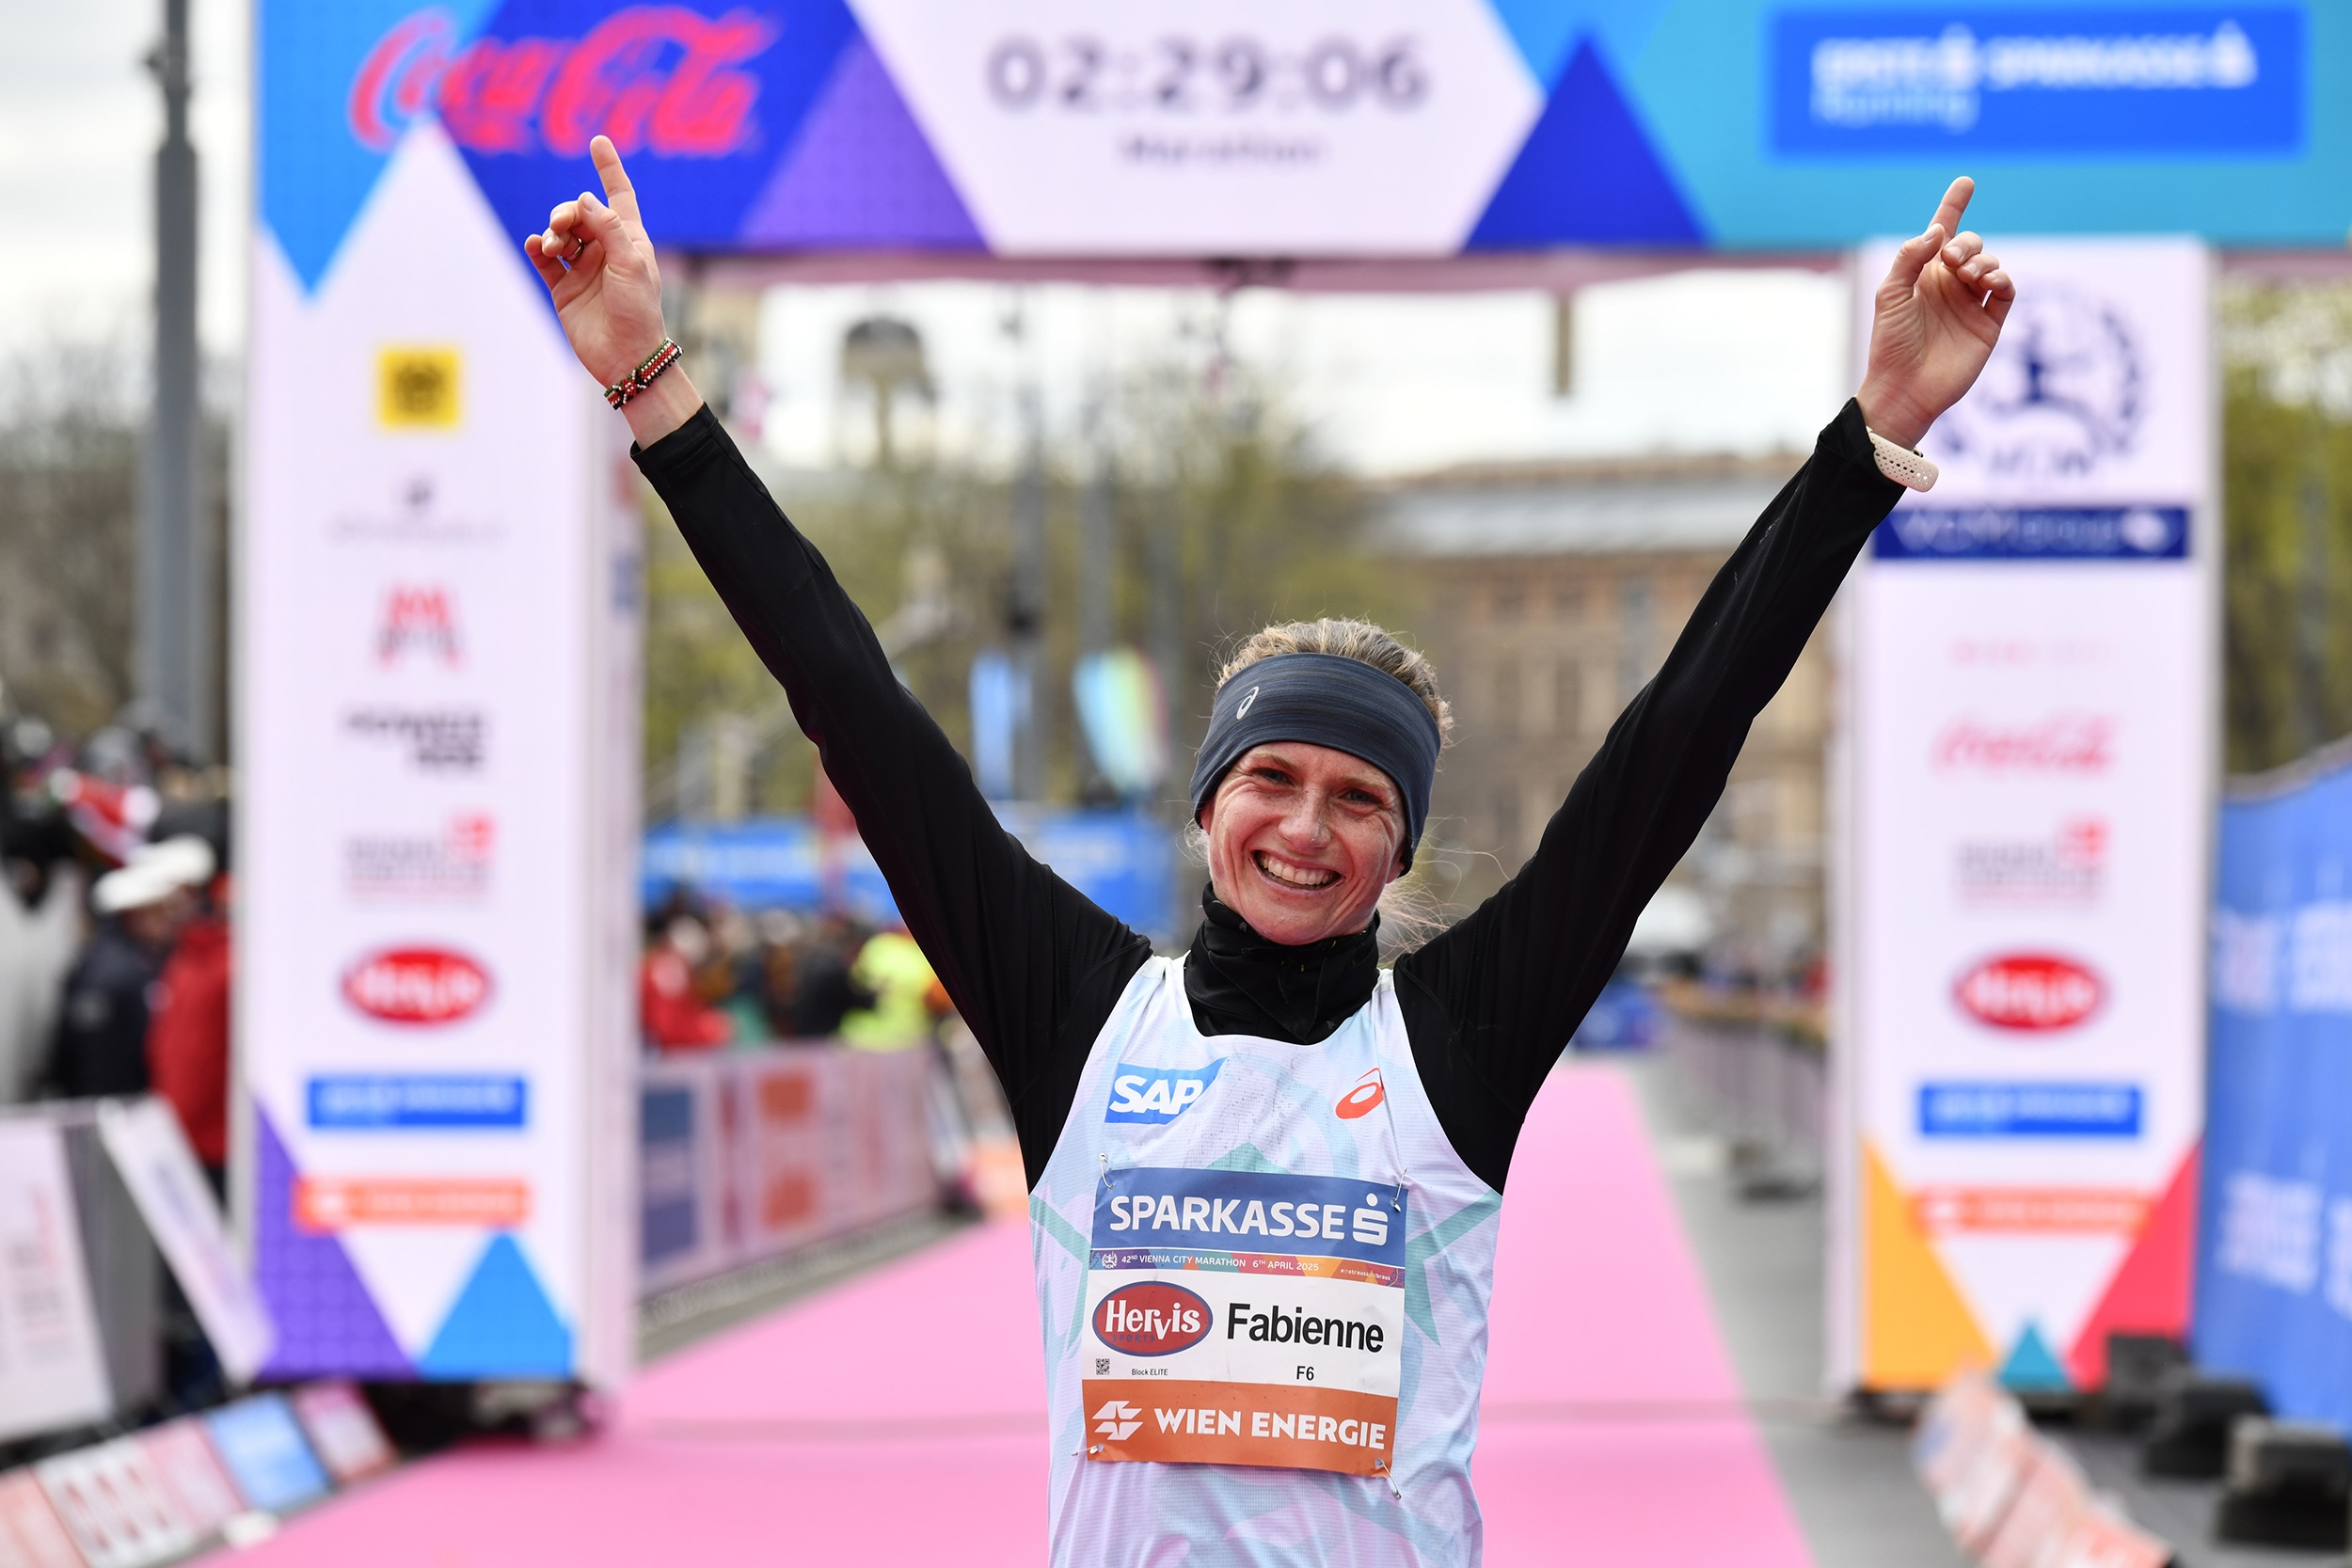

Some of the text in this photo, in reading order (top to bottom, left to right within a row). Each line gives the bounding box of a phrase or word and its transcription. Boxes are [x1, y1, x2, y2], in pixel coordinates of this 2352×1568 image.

[986, 34, 1430, 113] 02:29:06
[1109, 1079, 1204, 1115] SAP
[1109, 1196, 1346, 1240] SPARKASSE
[1121, 1255, 1319, 1271] 42ND VIENNA CITY MARATHON 6TH APRIL 2025
[1105, 1300, 1201, 1339] Hervis
[1227, 1303, 1384, 1353] Fabienne
[1296, 1366, 1315, 1381] F6
[1153, 1408, 1386, 1449] WIEN ENERGIE
